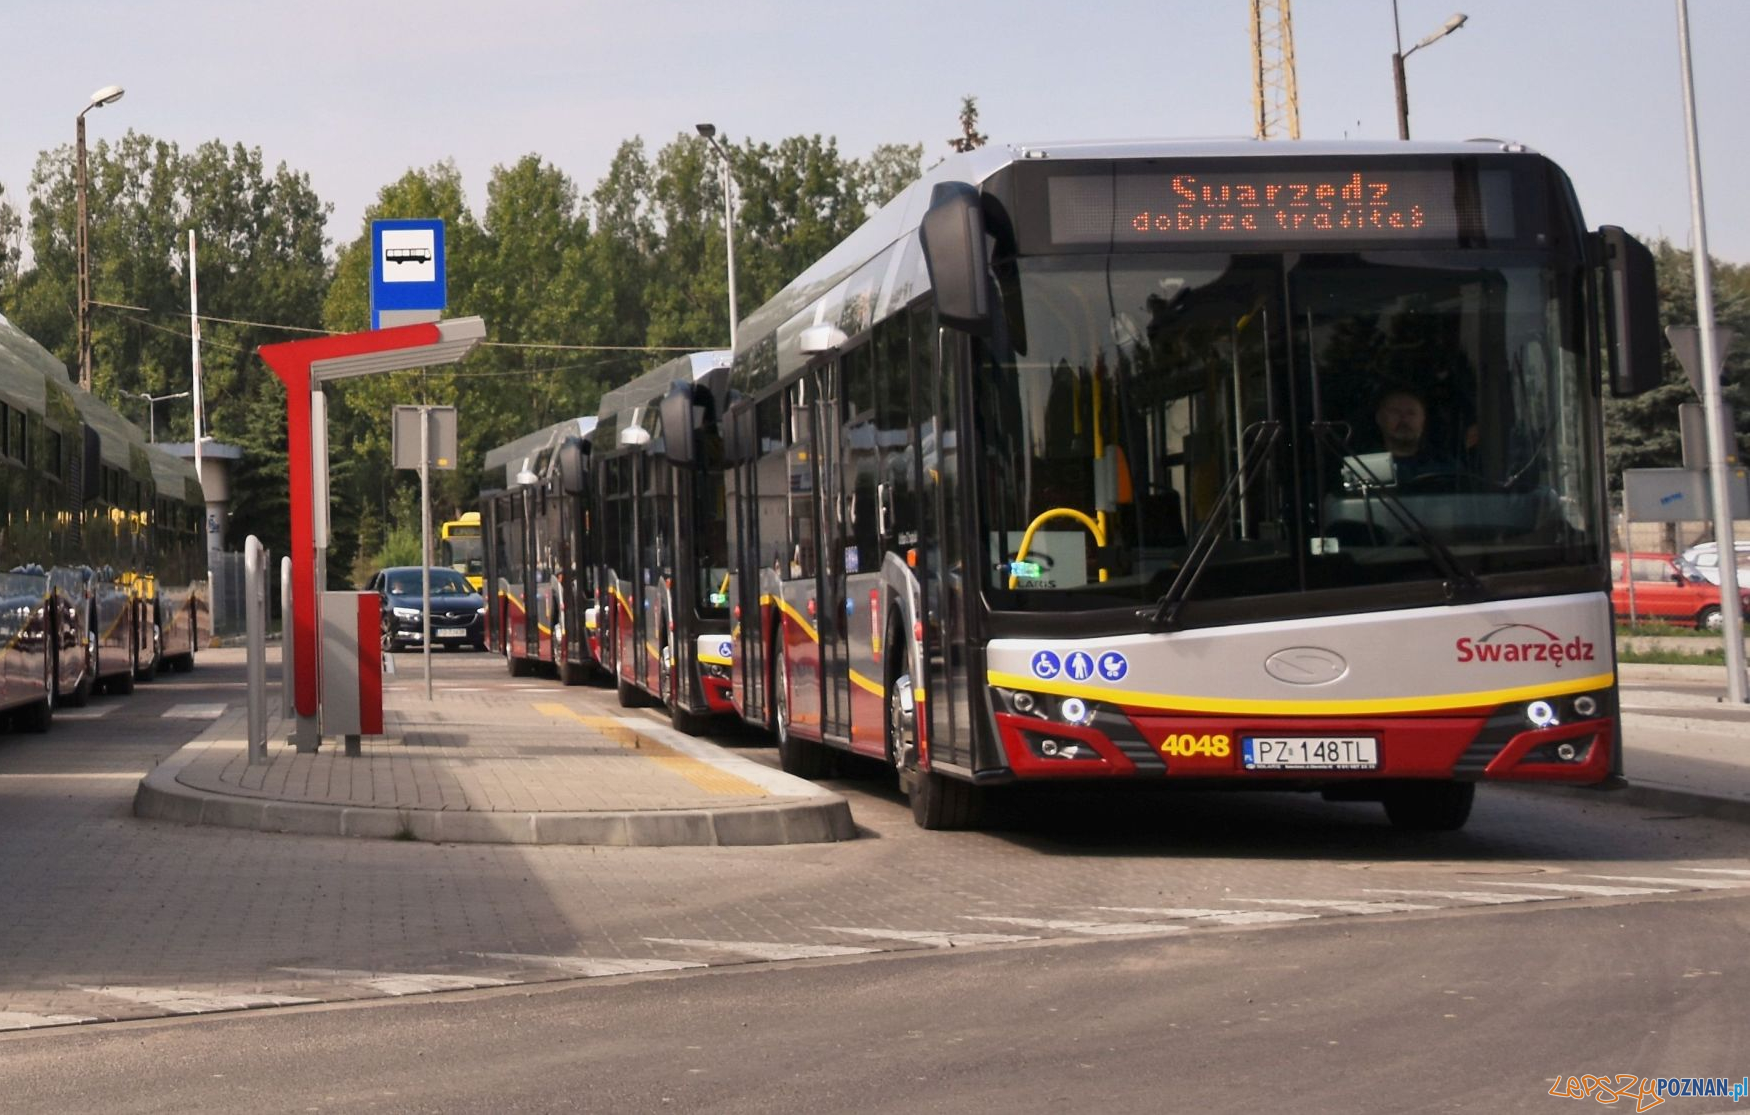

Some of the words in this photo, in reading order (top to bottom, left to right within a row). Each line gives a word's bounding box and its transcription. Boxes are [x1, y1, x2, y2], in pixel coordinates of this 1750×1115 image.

[1171, 173, 1389, 210] Swarzędz
[1132, 211, 1258, 231] dobrze
[1456, 636, 1595, 668] Swarzędz
[1161, 734, 1230, 757] 4048
[1259, 741, 1289, 762] PZ
[1300, 741, 1369, 762] 148TL
